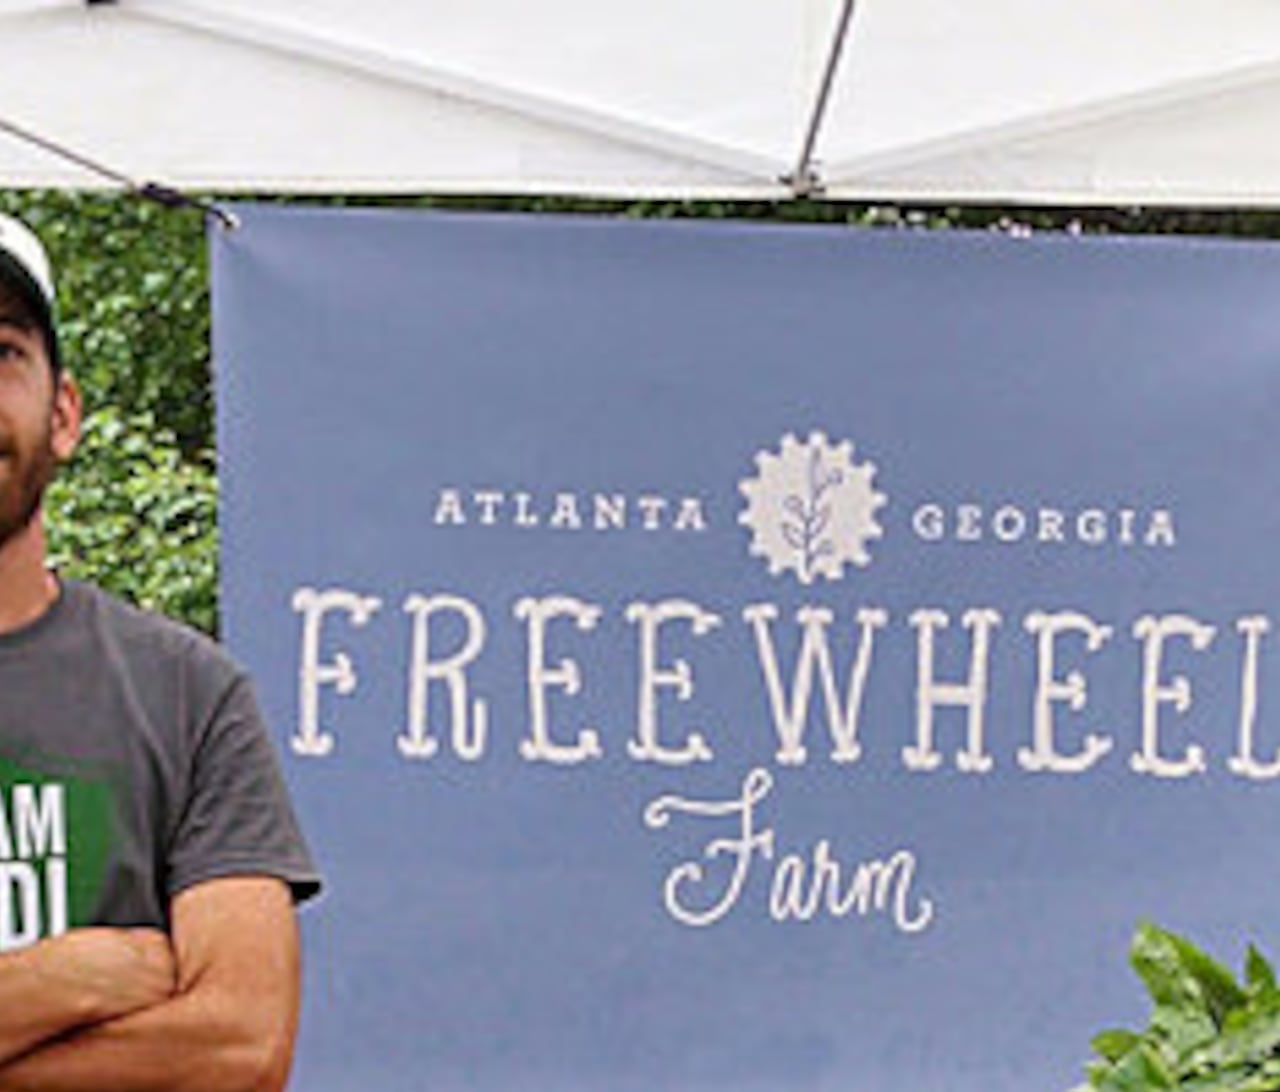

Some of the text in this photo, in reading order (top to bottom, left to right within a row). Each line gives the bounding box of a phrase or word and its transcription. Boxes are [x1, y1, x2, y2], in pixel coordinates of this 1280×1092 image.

[434, 489, 1177, 546] ATLANTA GEORGIA
[643, 768, 934, 932] Farm
